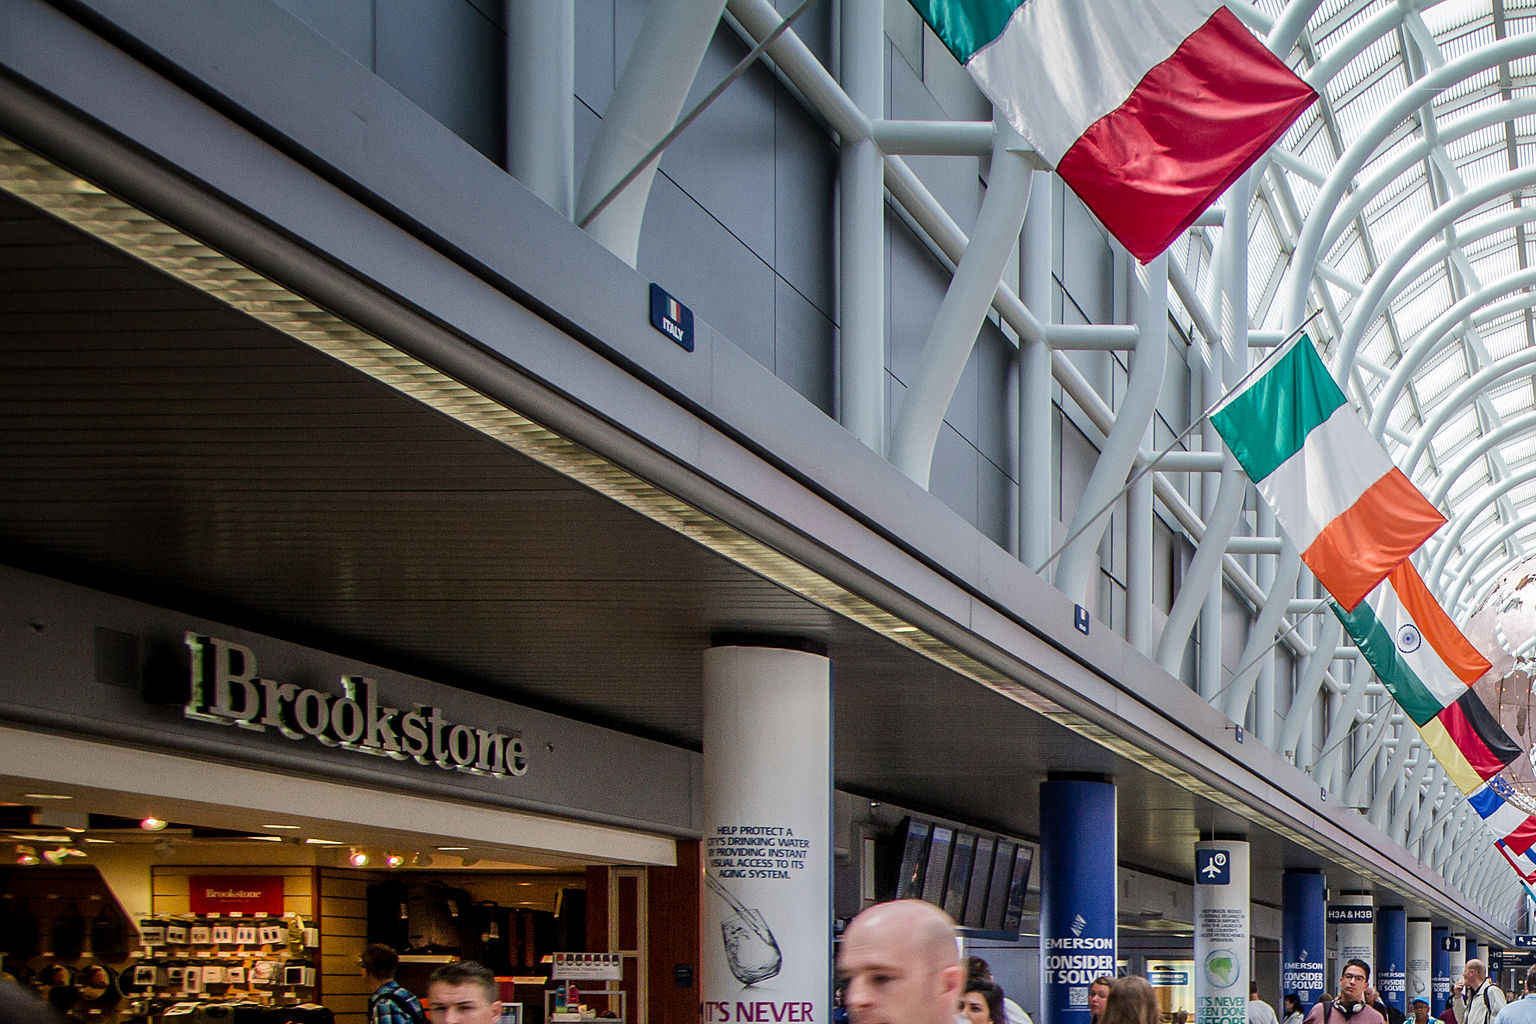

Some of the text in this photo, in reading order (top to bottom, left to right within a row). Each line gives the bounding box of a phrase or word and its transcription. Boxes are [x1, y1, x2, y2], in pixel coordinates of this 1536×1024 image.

[663, 317, 683, 341] ITALY
[185, 632, 529, 777] Brookstone
[717, 826, 793, 836] HELP PROTECT A
[728, 837, 775, 847] DRINKING
[778, 838, 810, 848] WATER
[716, 848, 766, 857] PROVIDING
[768, 848, 807, 858] INSTANT
[737, 859, 773, 868] ACCESS
[776, 860, 789, 868] TO
[791, 860, 804, 869] ITS
[719, 869, 746, 878] AGING
[1328, 911, 1372, 919] H3A & H3B
[1045, 937, 1113, 950] EMERSON
[1045, 955, 1113, 970] CONSIDER
[1284, 962, 1323, 970] EMERSON
[1045, 970, 1055, 984] IT
[1284, 972, 1323, 981] CONSIDER
[1292, 981, 1323, 989] SOLVED
[1214, 996, 1245, 1007] NEVER
[705, 1001, 814, 1023] IT'S NEVER
[1199, 1007, 1245, 1017] BEEN DONE
